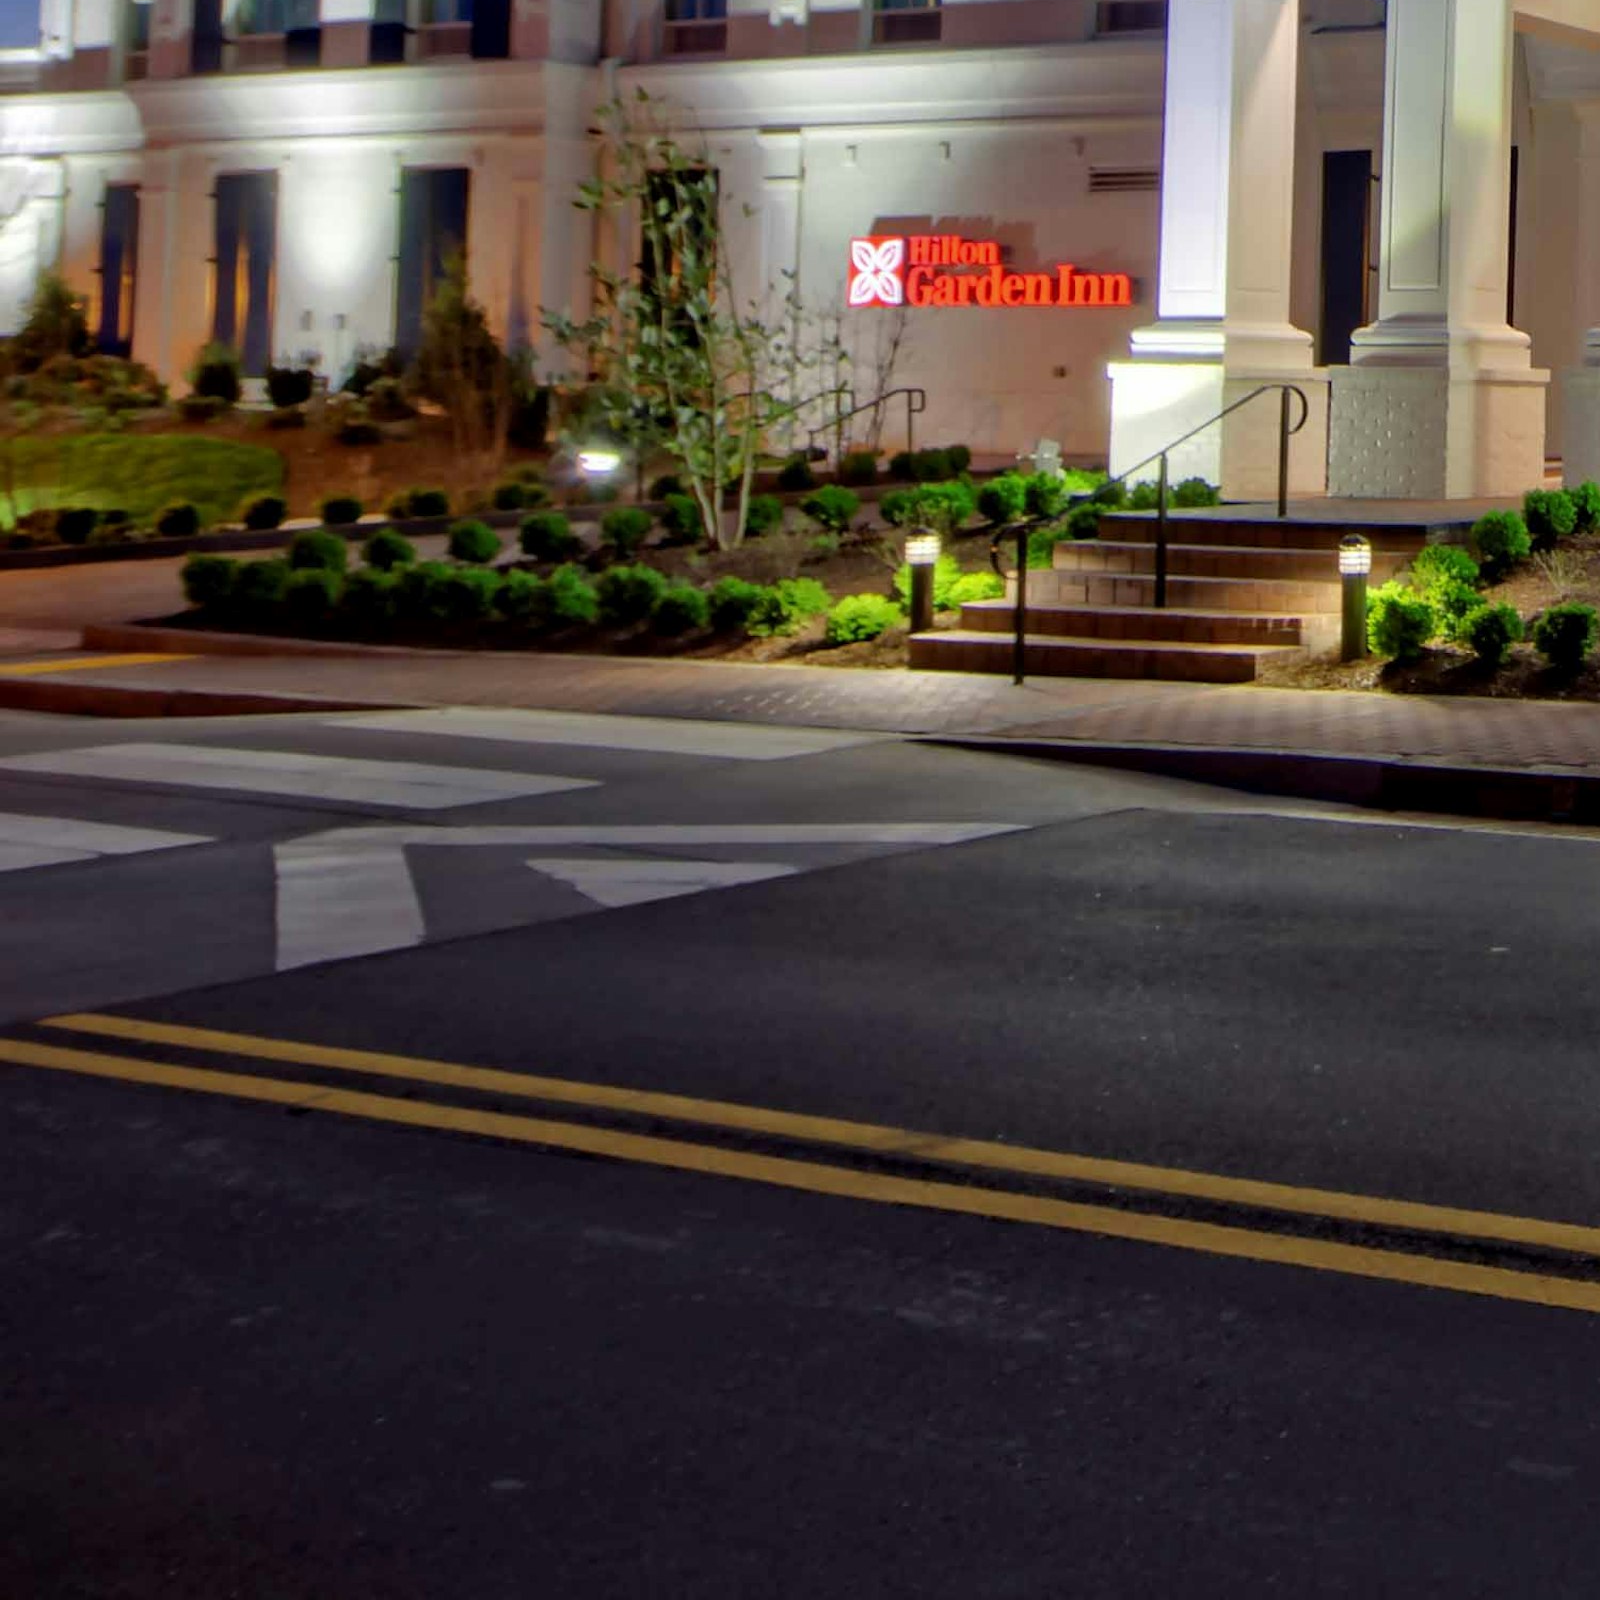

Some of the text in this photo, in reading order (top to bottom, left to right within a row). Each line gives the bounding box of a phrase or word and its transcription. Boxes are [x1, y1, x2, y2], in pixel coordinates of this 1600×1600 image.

[907, 236, 999, 265] Hilton
[906, 263, 1132, 306] Garden Inn
